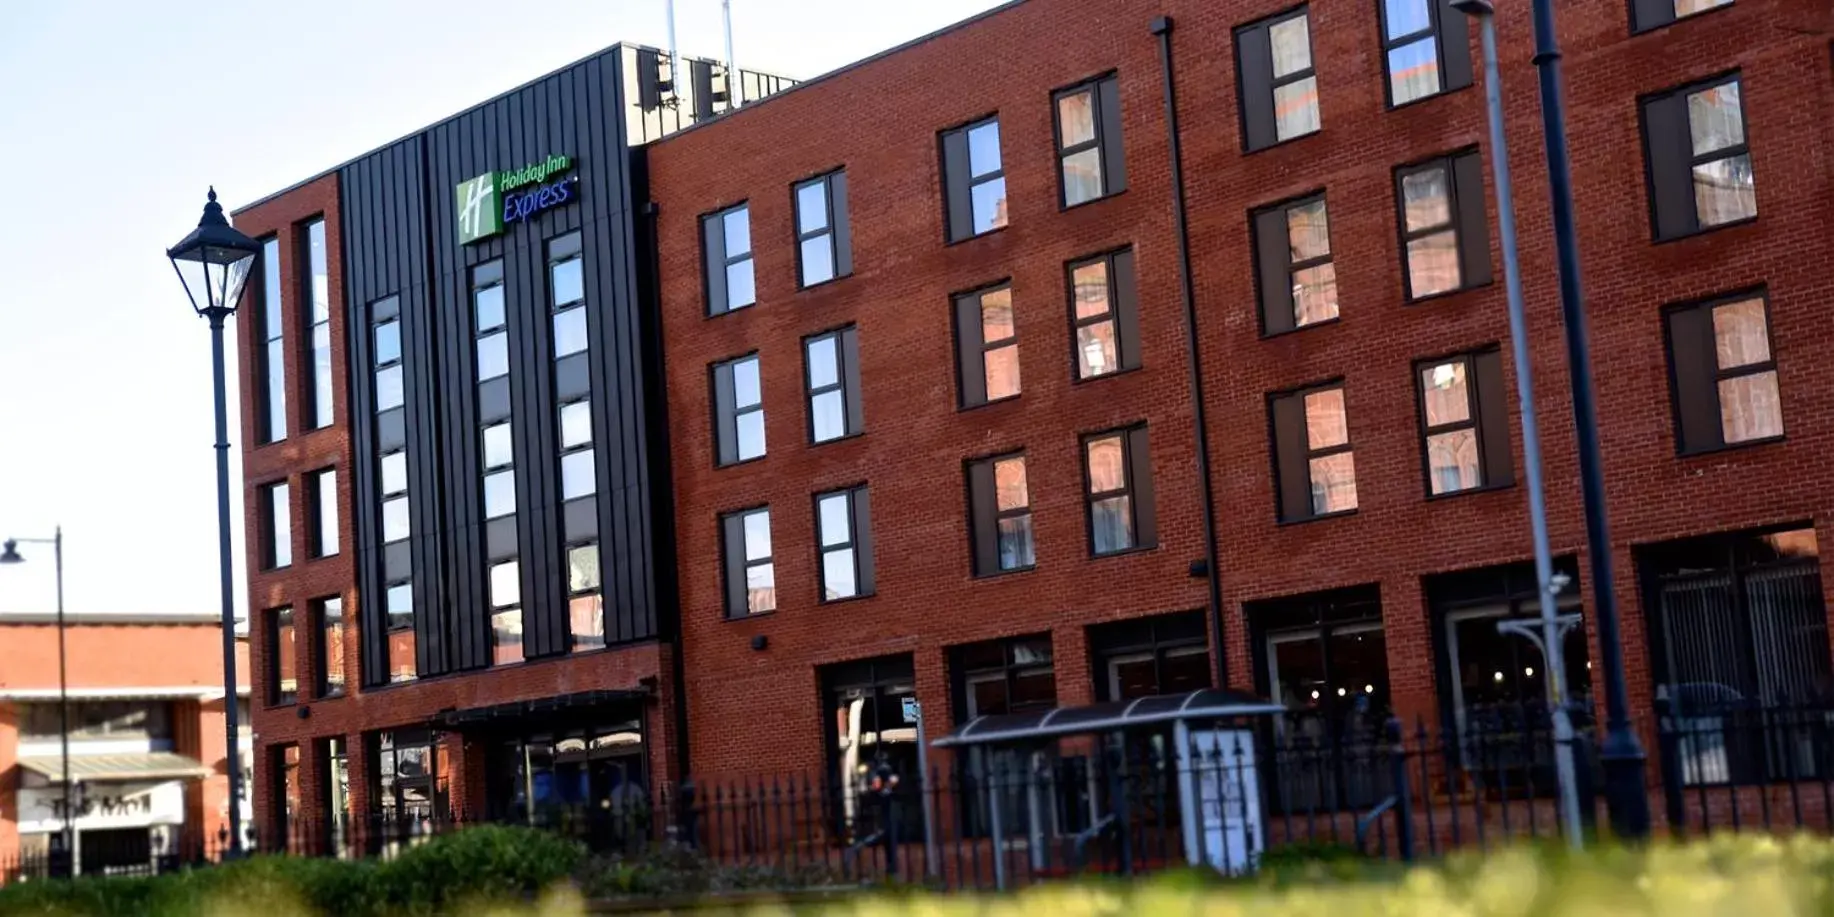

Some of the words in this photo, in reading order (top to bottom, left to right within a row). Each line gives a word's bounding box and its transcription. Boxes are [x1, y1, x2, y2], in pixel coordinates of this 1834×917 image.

[500, 163, 545, 192] Holiday
[547, 155, 566, 175] Inn
[503, 181, 568, 224] Express
